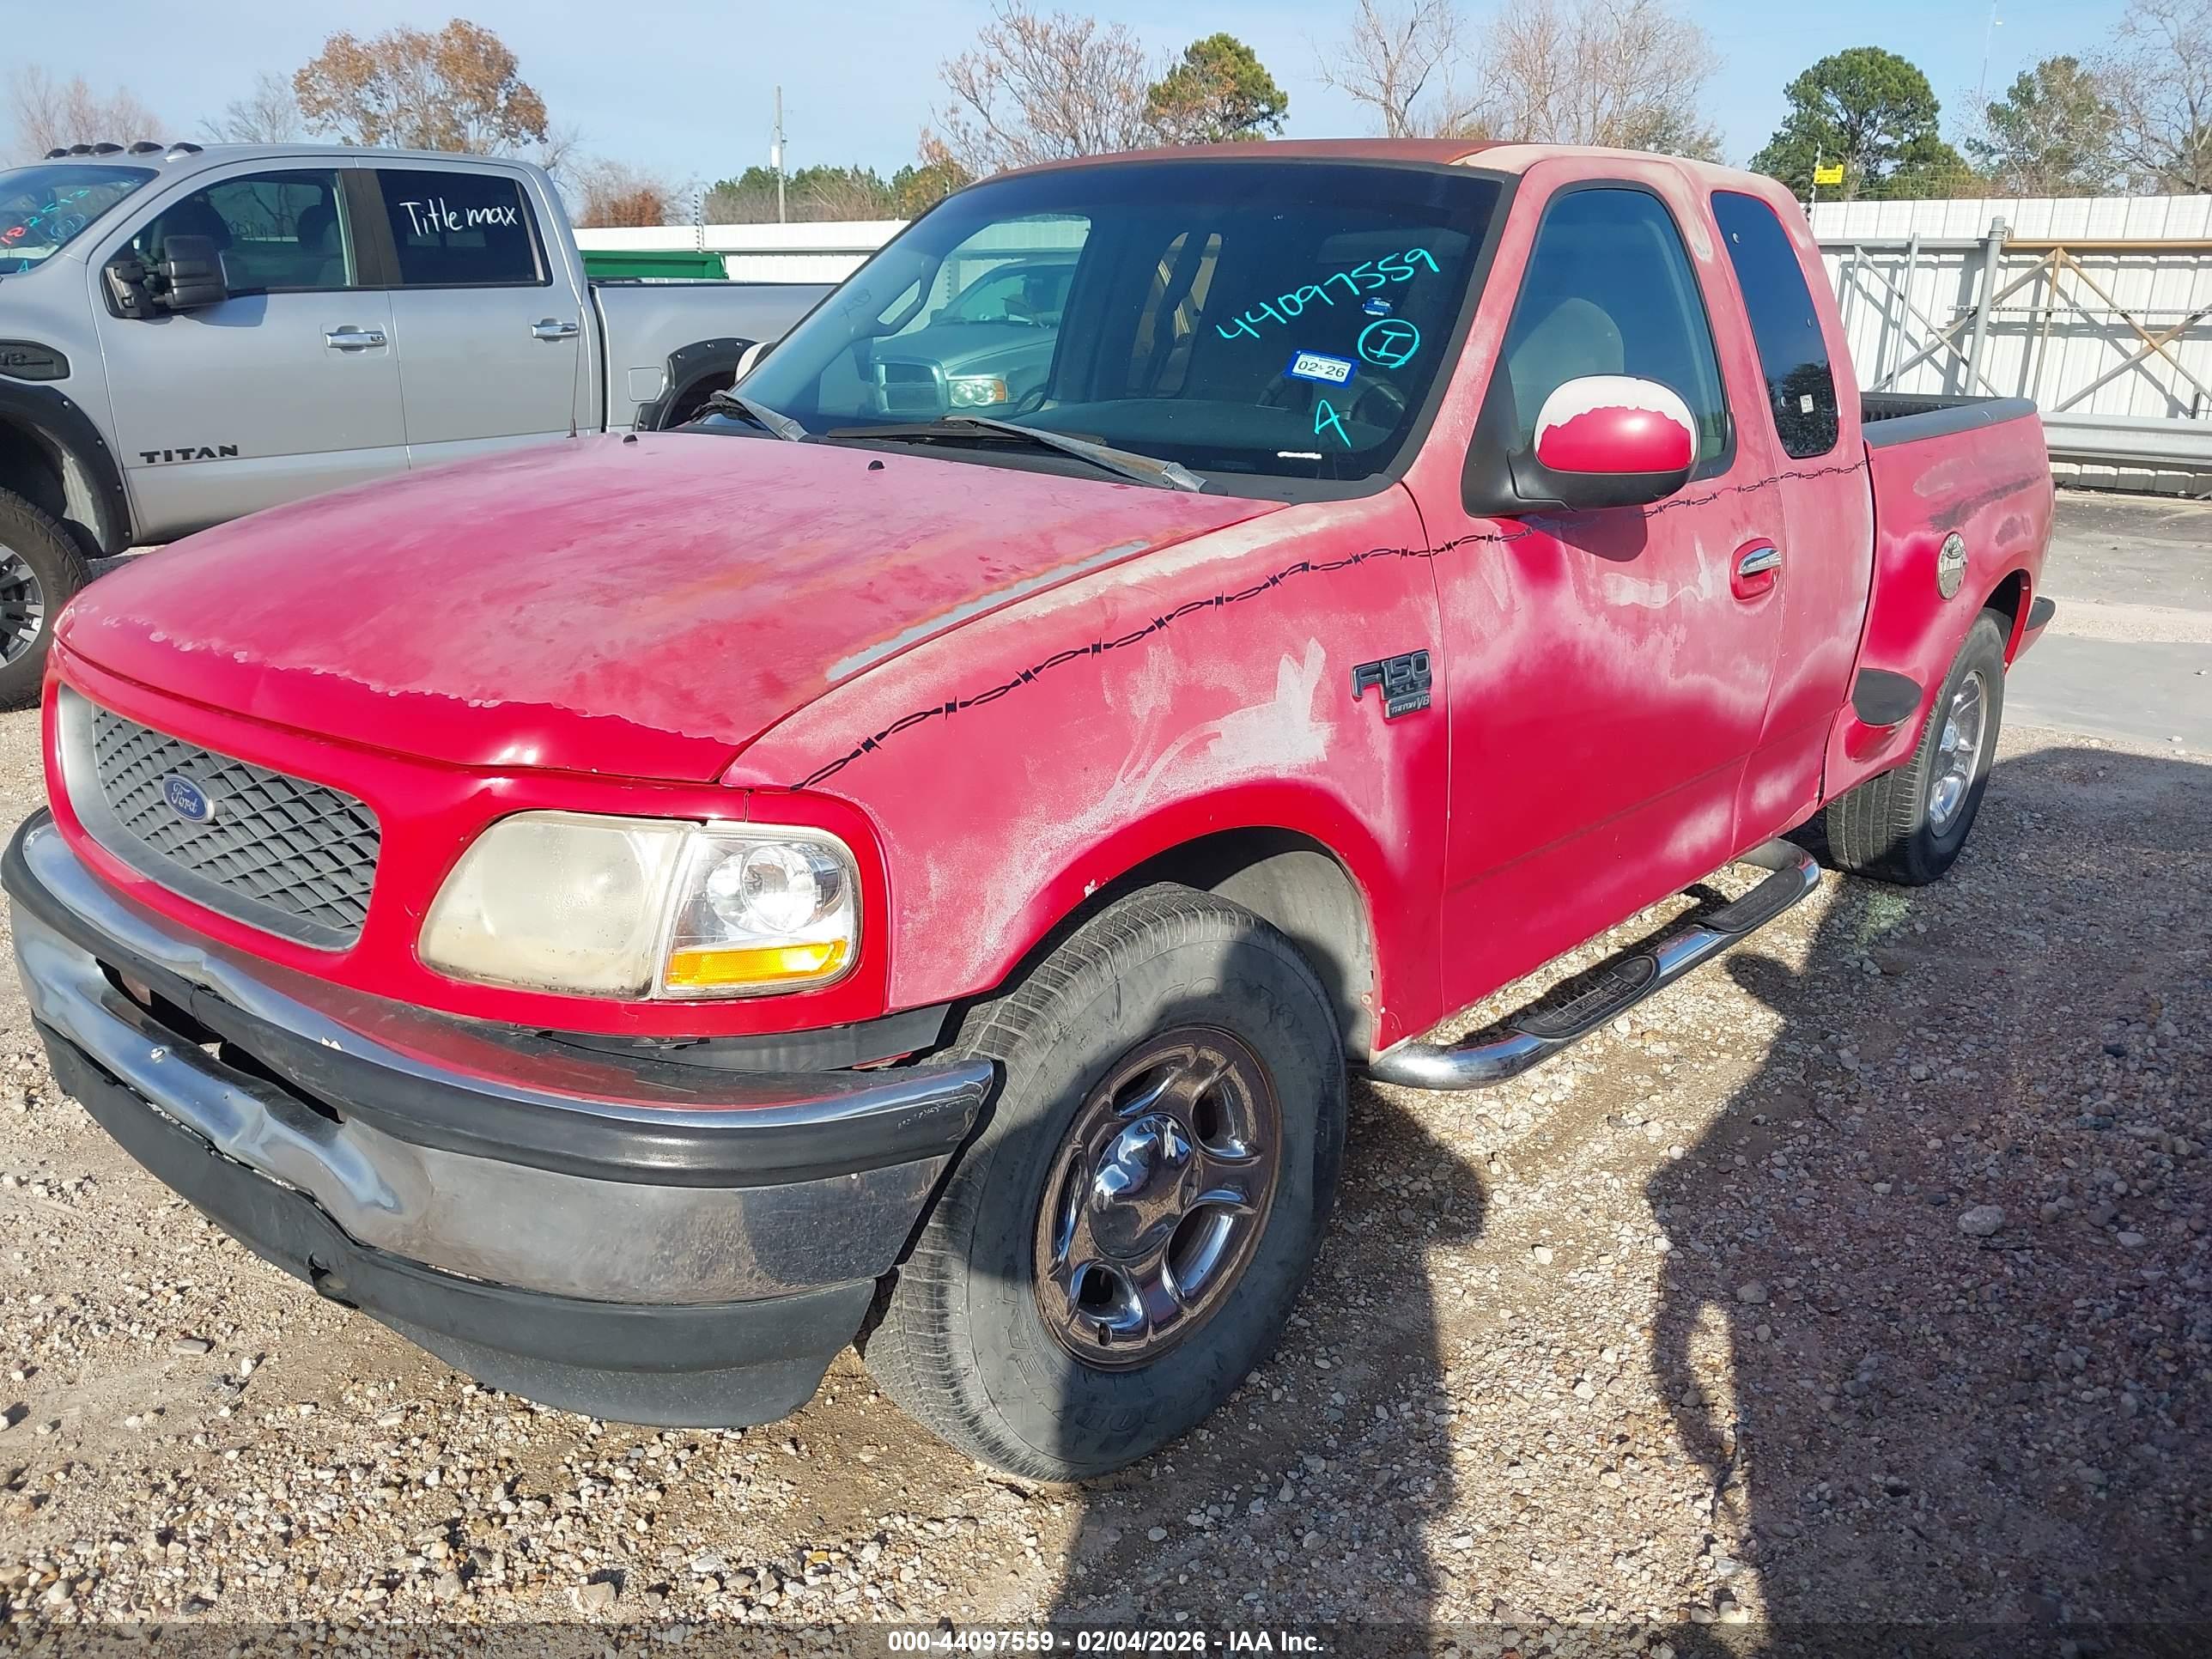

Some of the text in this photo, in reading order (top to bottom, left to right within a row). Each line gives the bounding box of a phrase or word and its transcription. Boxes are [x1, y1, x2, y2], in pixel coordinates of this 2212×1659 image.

[398, 197, 518, 237] Title max
[1216, 248, 1440, 339] 44097559
[1314, 399, 1352, 448] A
[139, 445, 239, 465] TITAN
[1392, 679, 1426, 695] XLT
[171, 782, 198, 814] Ford
